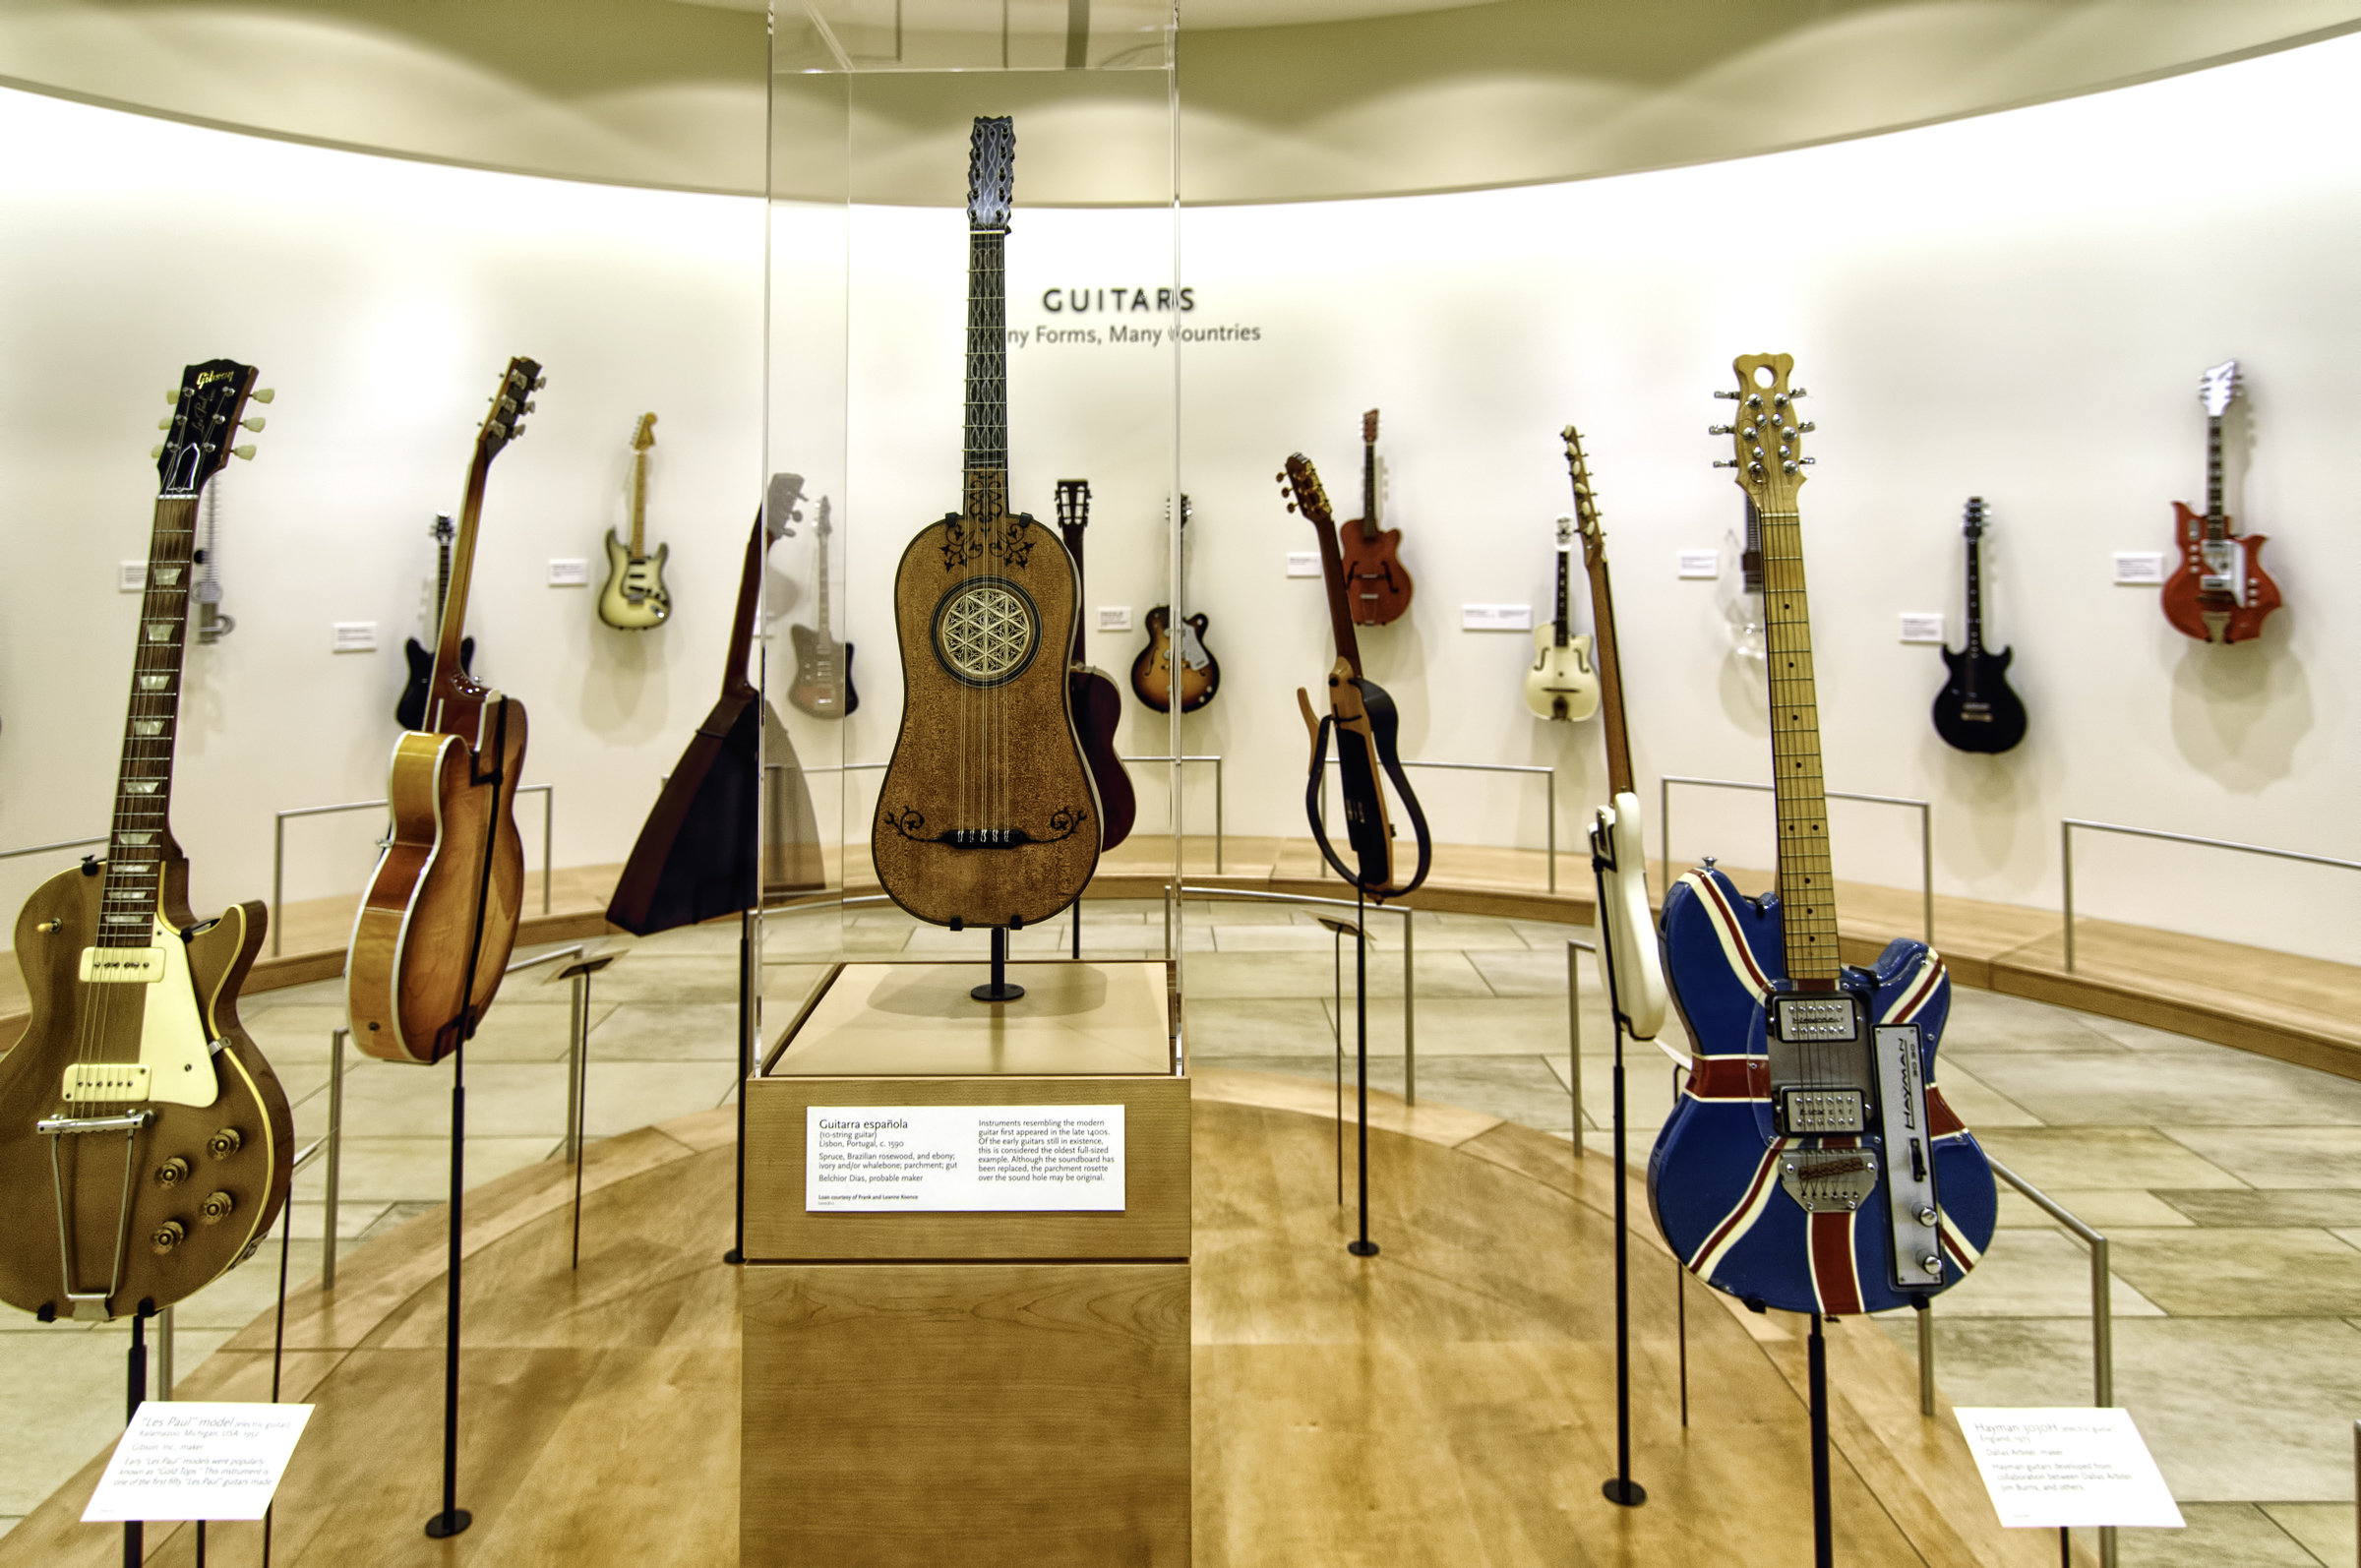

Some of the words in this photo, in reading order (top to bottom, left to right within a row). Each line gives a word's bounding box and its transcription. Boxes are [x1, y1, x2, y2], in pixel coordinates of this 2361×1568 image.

[1042, 287, 1195, 312] GUITARS
[1007, 329, 1029, 348] ny
[1036, 325, 1102, 345] Forms,
[1110, 325, 1162, 347] Many
[196, 370, 234, 390] Gibson
[1899, 1038, 1915, 1130] HAYMAN
[819, 1119, 860, 1133] Guitarra
[863, 1119, 908, 1133] española
[1023, 1119, 1062, 1128] resembling
[854, 1132, 877, 1141] guitar)
[978, 1130, 999, 1138] guitar
[1016, 1128, 1048, 1137] appeared
[847, 1140, 878, 1149] Portugal,
[1002, 1137, 1019, 1146] early
[1021, 1138, 1045, 1147] guitars
[1069, 1138, 1103, 1147] existence,
[819, 1152, 845, 1161] Spruce,
[877, 1152, 914, 1162] rosewood,
[917, 1152, 930, 1162] and
[932, 1152, 955, 1161] ebony;
[978, 1156, 1009, 1164] example.
[1011, 1155, 1043, 1165] Although
[837, 1161, 860, 1170] and/or
[904, 1161, 944, 1170] parchment;
[946, 1162, 957, 1171] gut
[998, 1164, 1029, 1173] replaced,
[1044, 1164, 1082, 1174] parchment
[869, 1174, 900, 1183] probable
[1076, 1173, 1105, 1183] original.
